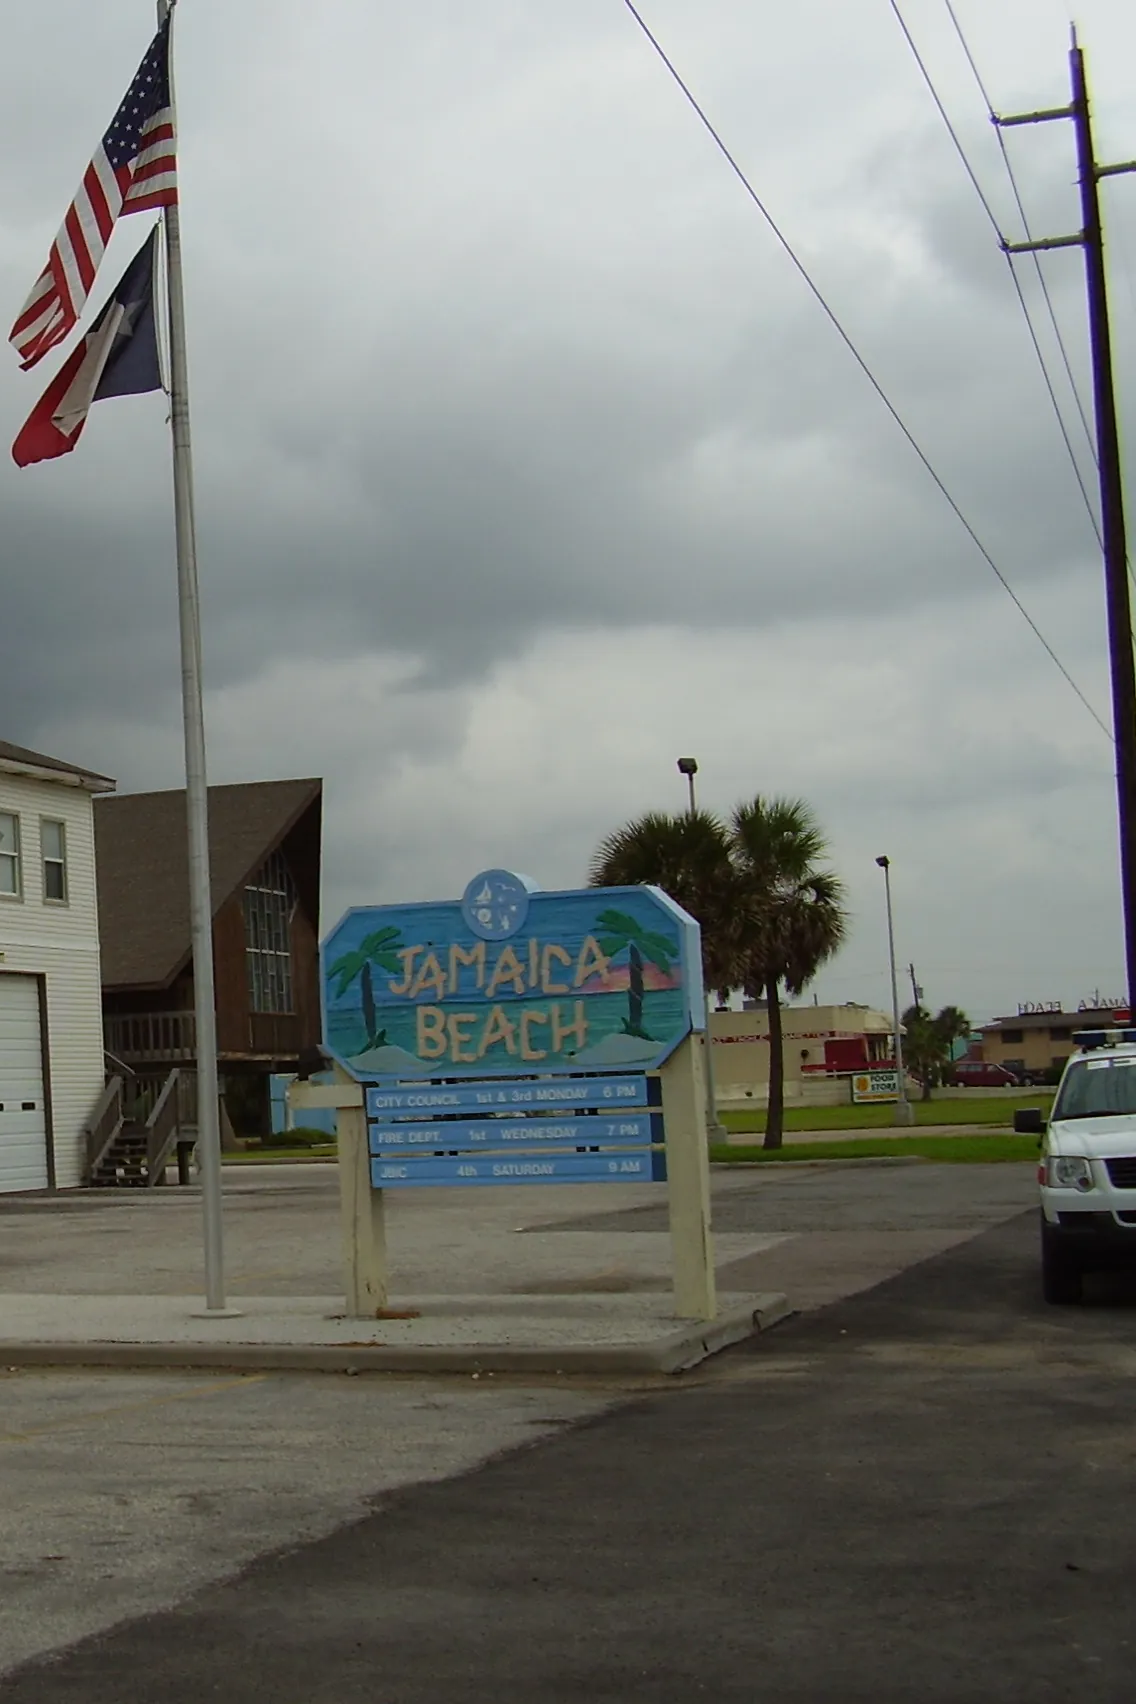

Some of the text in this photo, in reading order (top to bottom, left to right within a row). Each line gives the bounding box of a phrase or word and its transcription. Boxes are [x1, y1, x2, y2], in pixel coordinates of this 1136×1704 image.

[388, 935, 612, 999] JAMAICA
[416, 999, 590, 1063] BEACH
[870, 1074, 895, 1083] FOOD
[871, 1082, 897, 1092] STORE
[375, 1085, 637, 1109] CITY COUNCIL 1st & 3rd MONDAY 6 PM
[377, 1123, 639, 1144] FIRE DEPT. 1st WEDNESDAY 7 PM
[456, 1164, 478, 1177] 4th
[492, 1163, 556, 1177] SATURDAY
[607, 1161, 617, 1173] 9
[620, 1159, 641, 1173] AM
